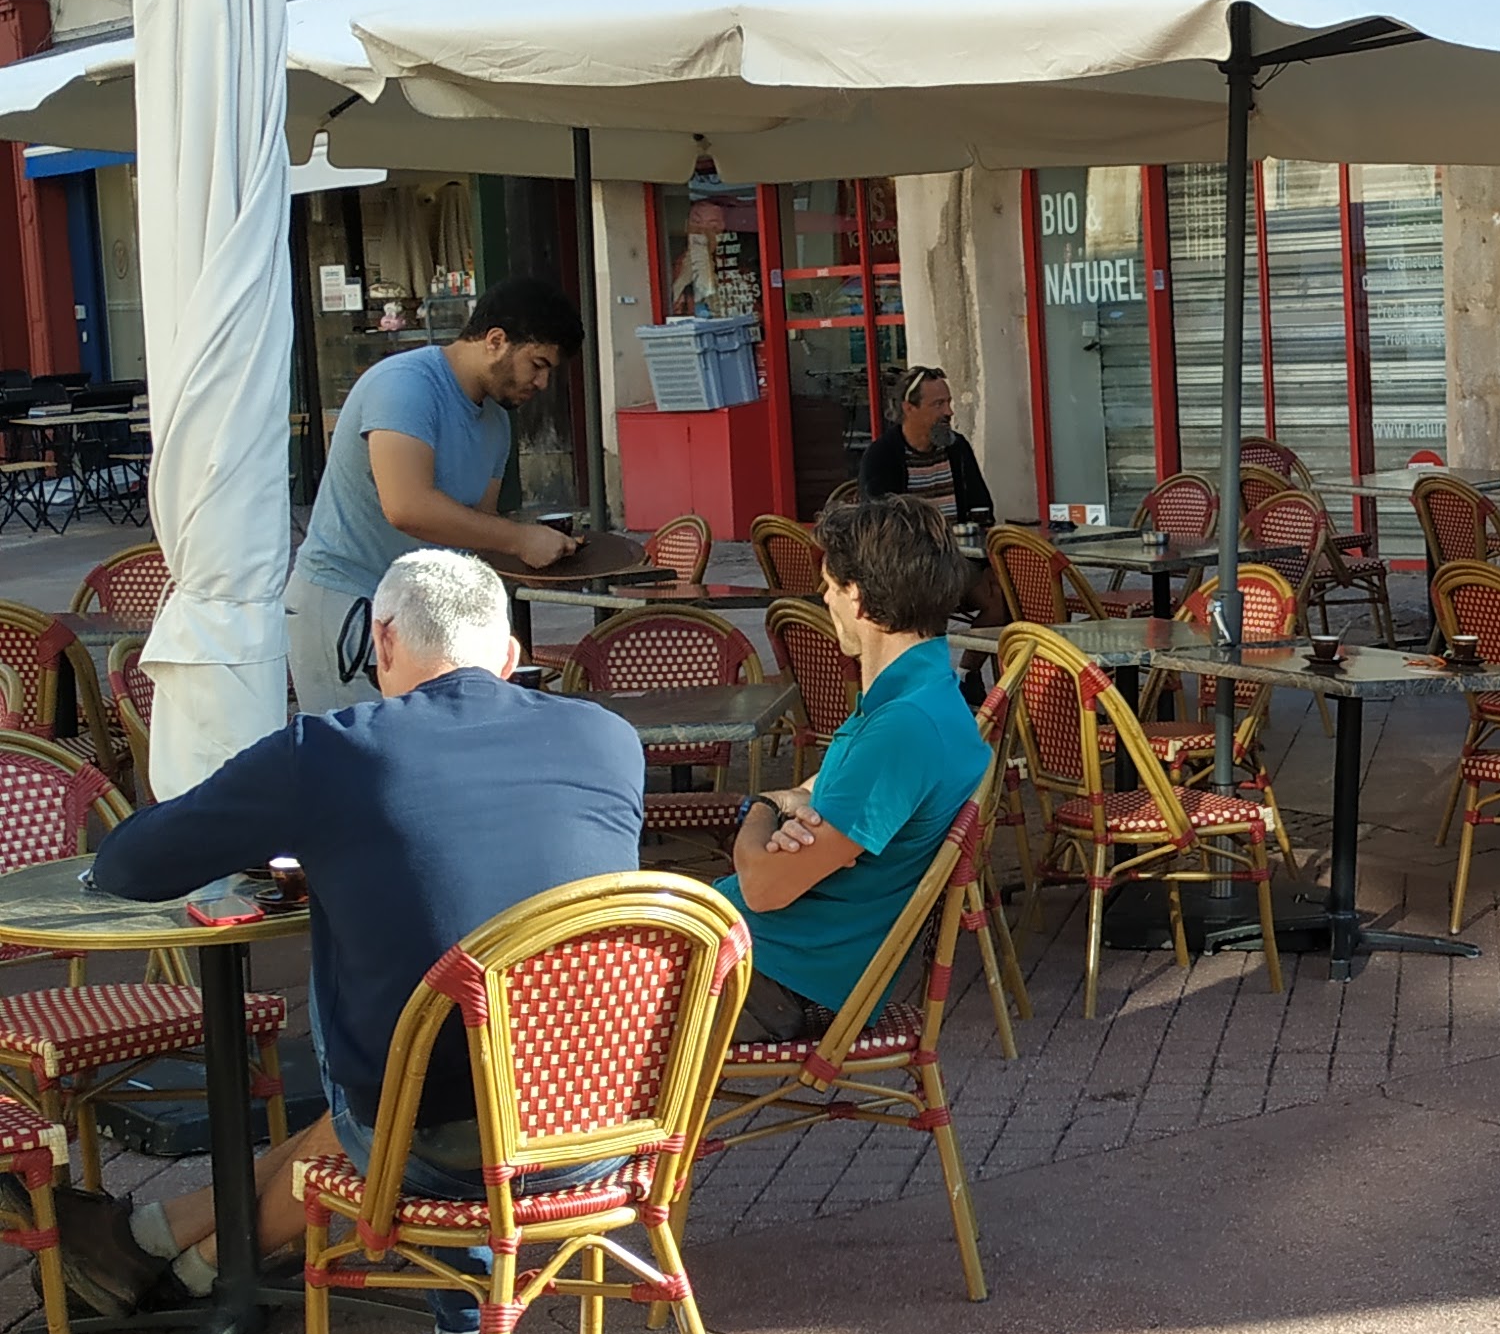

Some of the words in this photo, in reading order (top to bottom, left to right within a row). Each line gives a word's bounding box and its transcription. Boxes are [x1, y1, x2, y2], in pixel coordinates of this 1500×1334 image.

[1040, 192, 1078, 236] BIO
[1086, 194, 1103, 232] &
[1044, 258, 1143, 305] NATUREL
